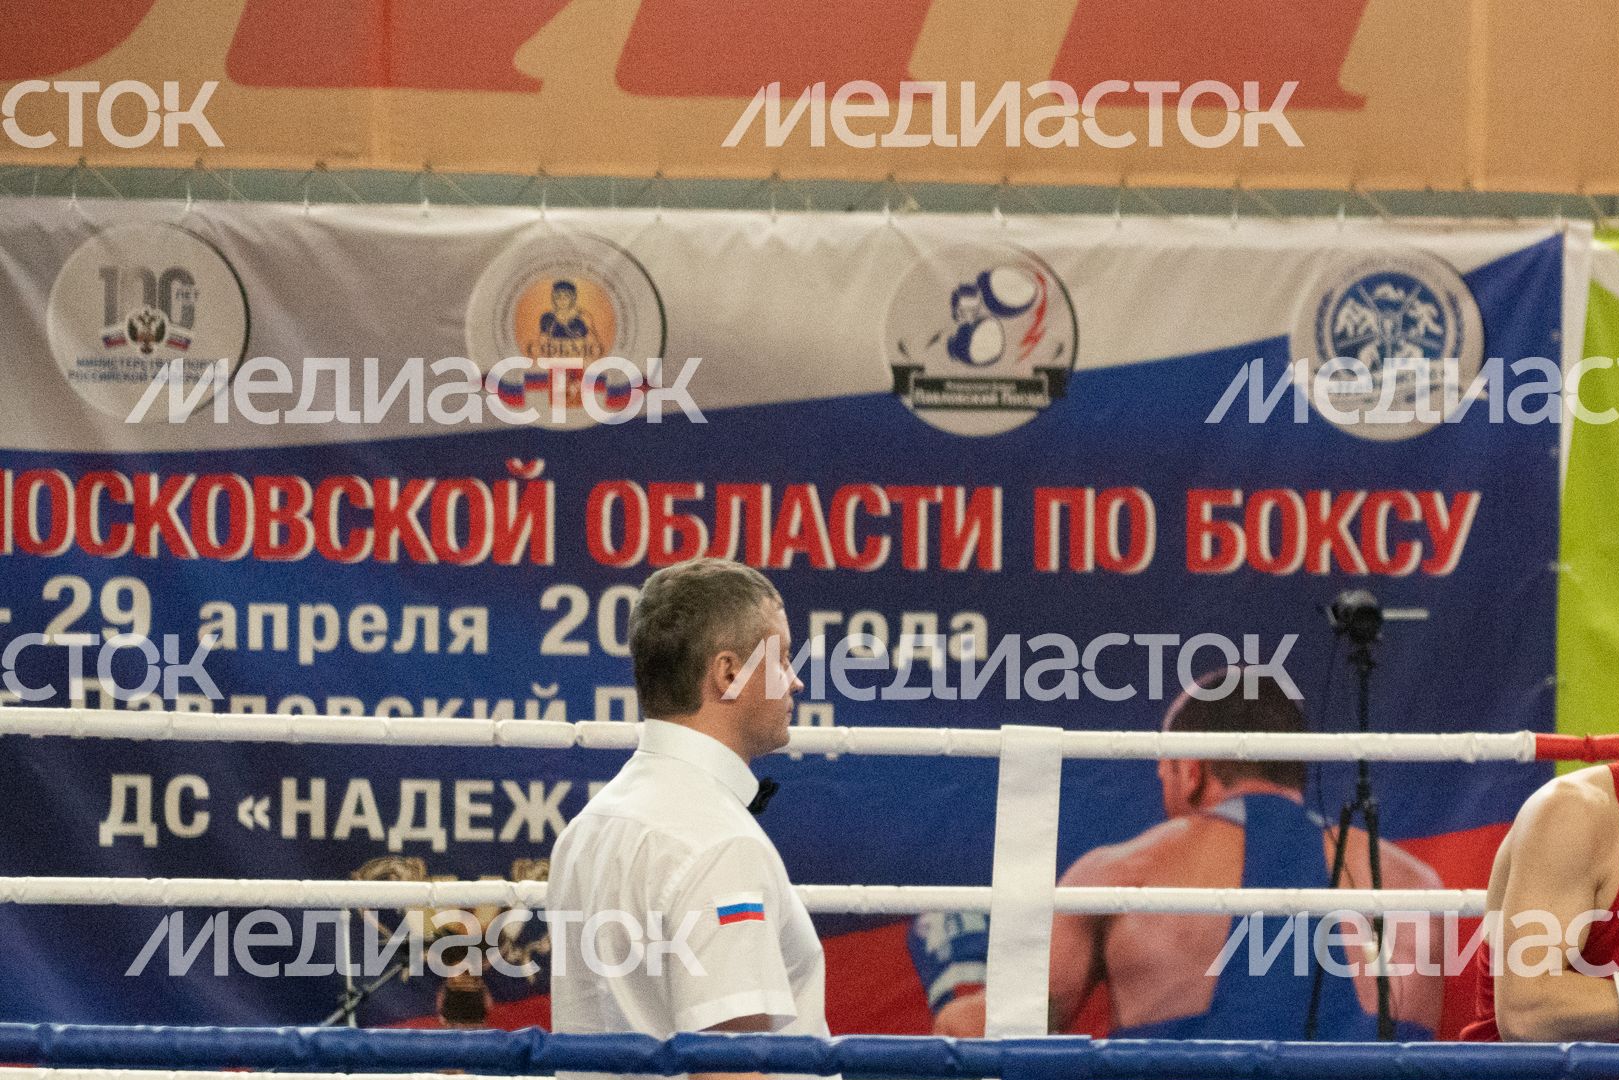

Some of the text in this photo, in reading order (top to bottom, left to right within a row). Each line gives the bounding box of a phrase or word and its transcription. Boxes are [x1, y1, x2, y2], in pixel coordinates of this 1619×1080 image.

[0, 458, 1481, 577] ОСКОВСКОЙ ОБЛАСТИ ПО БОКСУ
[42, 575, 152, 649] 29
[198, 600, 488, 664] апреля
[809, 611, 989, 672] года
[100, 773, 604, 853] ДС «НАДЕЖ
